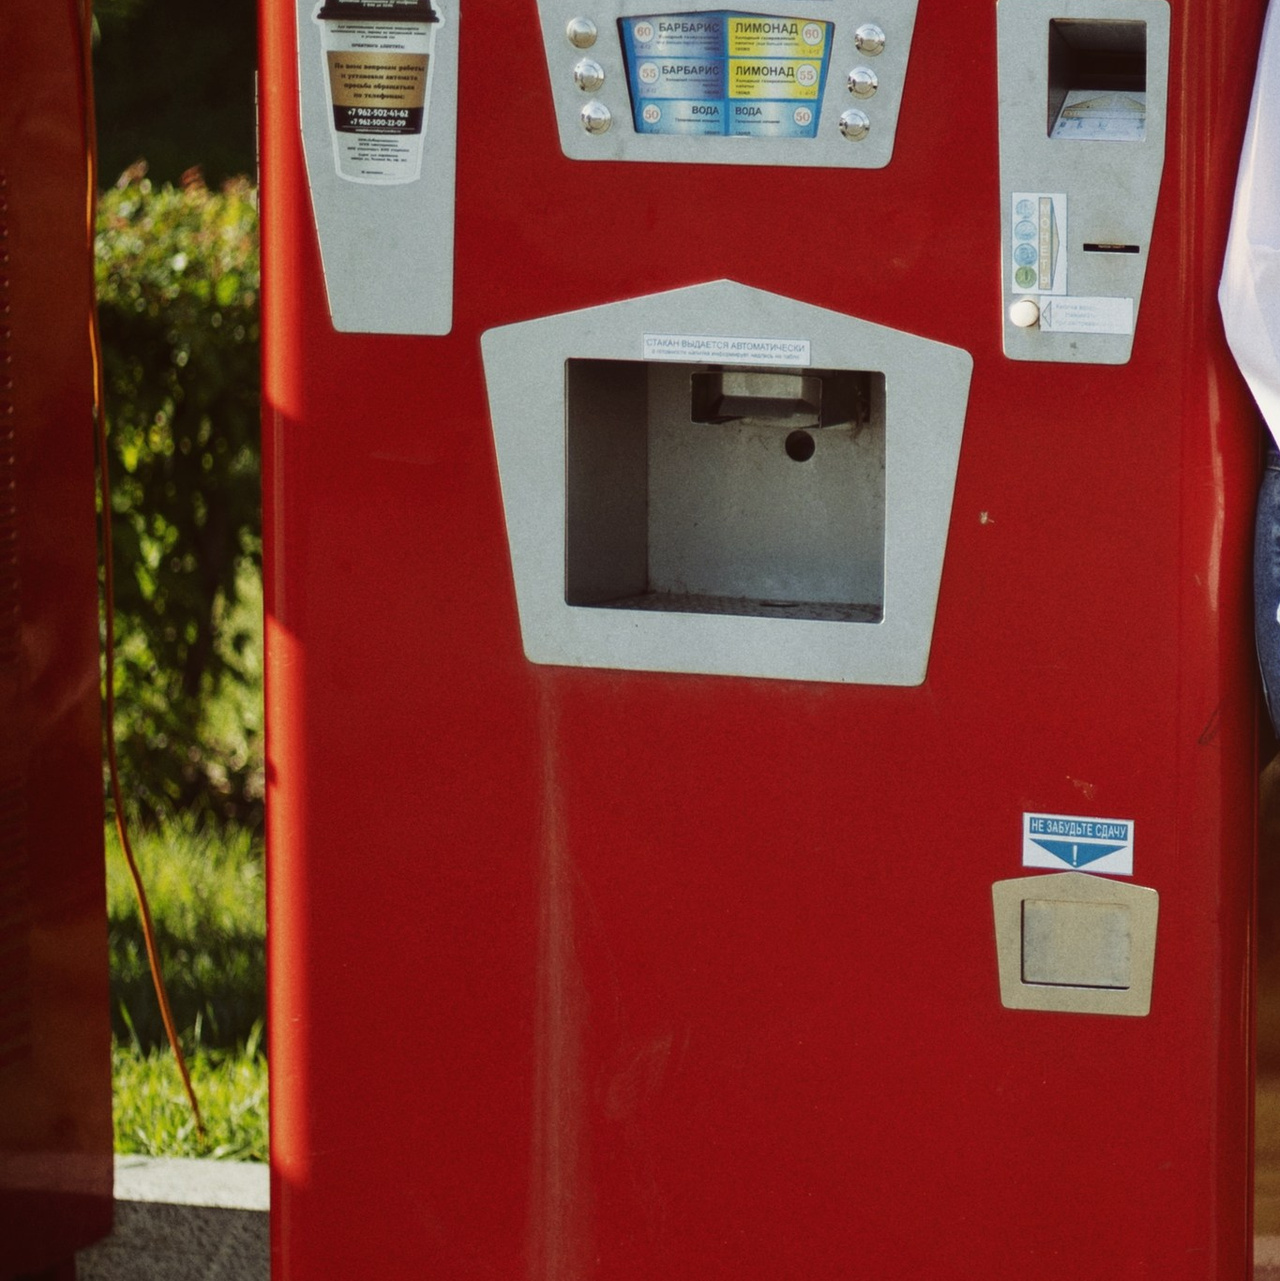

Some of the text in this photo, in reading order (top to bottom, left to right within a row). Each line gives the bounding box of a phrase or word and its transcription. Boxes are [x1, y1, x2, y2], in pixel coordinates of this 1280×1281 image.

[637, 26, 651, 37] 60
[659, 22, 720, 33] БАРБАРИС
[735, 22, 799, 35] ЛИМОНАД
[805, 28, 819, 39] 60
[642, 68, 657, 79] 55
[662, 65, 720, 75] БАРБАРИС
[735, 66, 795, 78] ЛИМОНАД
[799, 70, 814, 81] 55
[347, 108, 409, 118] +7 962-502-41-62
[645, 109, 659, 120] 50
[691, 105, 719, 116] ВОДА
[735, 106, 762, 117] ВОДА
[795, 111, 810, 122] 50
[646, 338, 806, 353] СТАКАН ВЫДАЕТСЯ АВТОМАТИЧЕСКИ
[1031, 820, 1127, 839] НЕ ЗАБУДЬТЕ СДАЧУ
